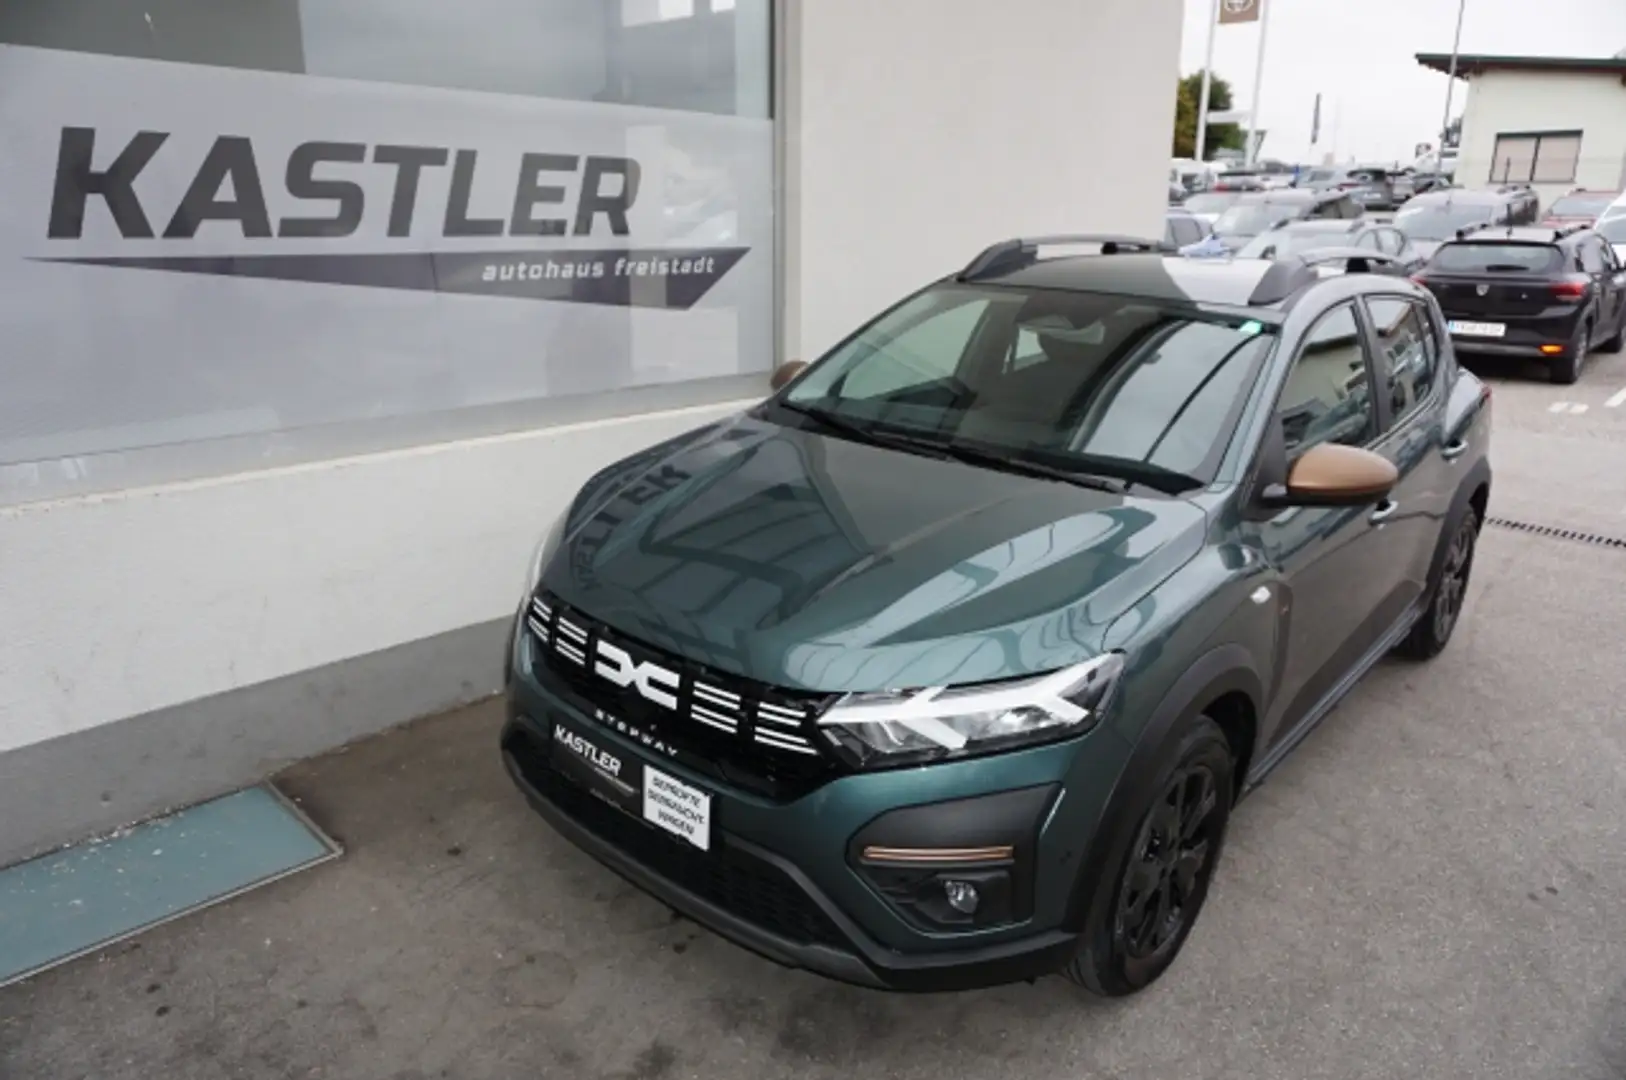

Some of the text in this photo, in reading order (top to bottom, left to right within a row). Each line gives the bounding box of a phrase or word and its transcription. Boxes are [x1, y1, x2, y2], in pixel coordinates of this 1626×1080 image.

[47, 126, 641, 239] KASTLER
[482, 257, 715, 281] autohaus freistadt
[554, 724, 622, 776] KASTLER
